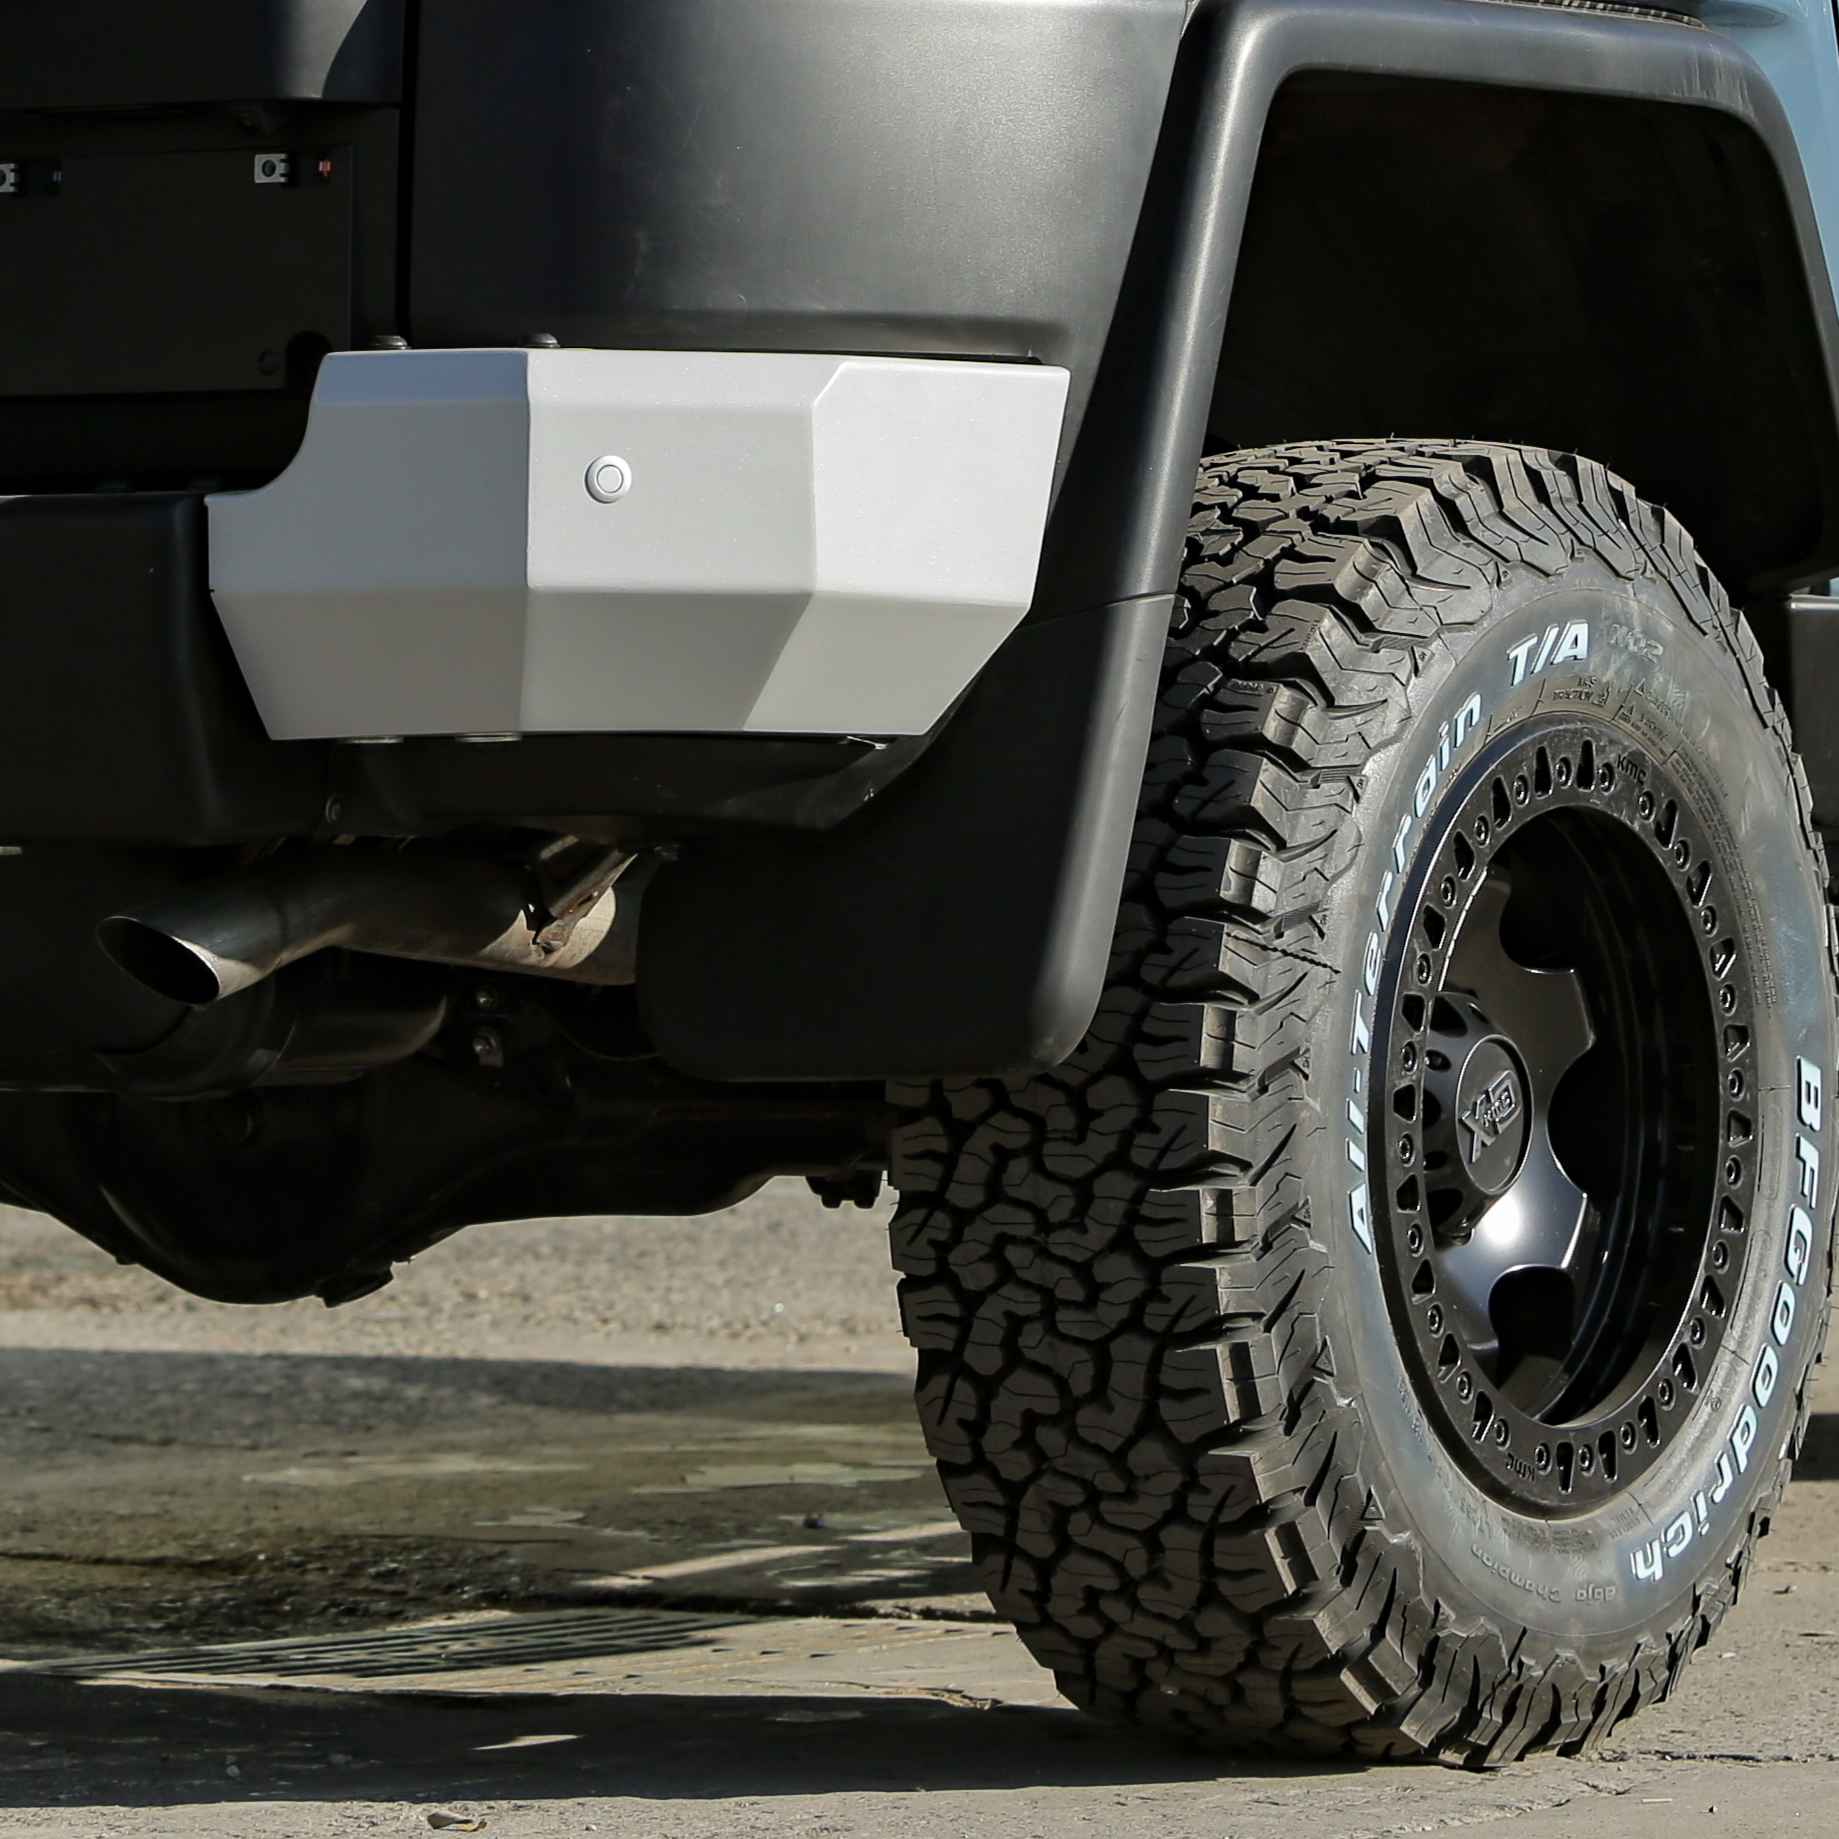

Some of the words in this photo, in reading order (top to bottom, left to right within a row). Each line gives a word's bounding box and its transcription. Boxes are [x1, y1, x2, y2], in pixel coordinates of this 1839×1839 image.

[1346, 690, 1483, 1254] All-Terrain
[1508, 620, 1589, 686] T/A
[1628, 1056, 1822, 1582] BFGoodrich
